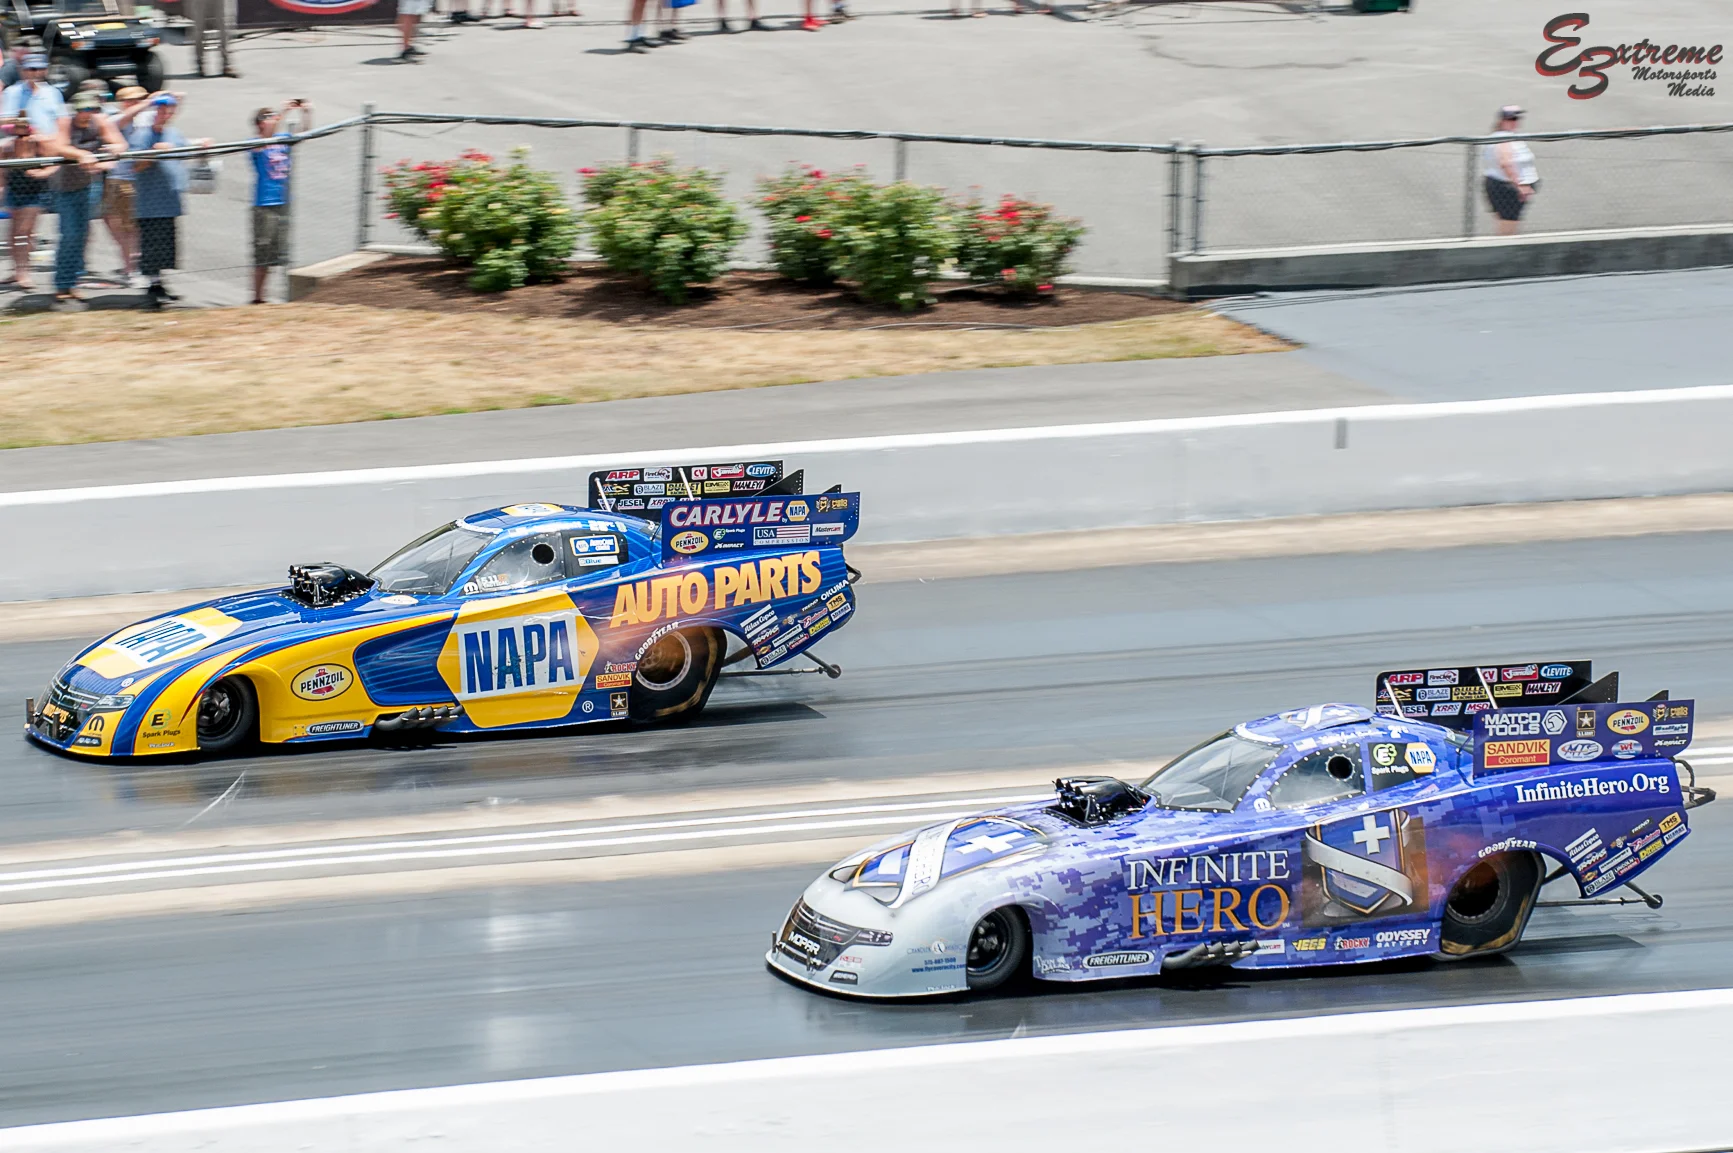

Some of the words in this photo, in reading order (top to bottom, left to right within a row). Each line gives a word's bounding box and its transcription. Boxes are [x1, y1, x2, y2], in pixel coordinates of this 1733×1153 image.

[607, 470, 640, 480] ARP
[693, 469, 705, 477] CV
[746, 464, 777, 477] CLEVITE
[618, 498, 643, 507] JESEL
[670, 501, 784, 528] CARLYLE
[788, 505, 807, 517] NAPA
[756, 529, 776, 538] USA
[675, 535, 705, 548] PENNZOIL
[754, 537, 809, 545] COMPRESSION
[609, 571, 709, 630] AUTO
[713, 551, 822, 610] PARTS
[820, 579, 850, 601] OKUMA
[828, 594, 843, 608] TMS
[744, 617, 761, 634] Atlas
[757, 609, 776, 625] Copco
[113, 619, 208, 663] NAPA
[634, 620, 682, 661] GOODYEAR
[464, 619, 576, 694] NAPA
[611, 662, 638, 672] ROCKY
[1540, 665, 1572, 678] CLEVITE
[300, 673, 346, 694] PENNZOIL
[597, 673, 630, 683] SANDVIK
[1388, 673, 1423, 683] ARP
[1427, 688, 1449, 696] BLAZE
[1453, 686, 1488, 697] BULLE
[1435, 703, 1454, 713] XRP
[1467, 702, 1488, 711] MSD
[1484, 712, 1541, 726] MATCO
[1613, 715, 1645, 728] PENNZOIL
[143, 730, 161, 739] Spark
[162, 729, 181, 738] Plugs
[310, 721, 361, 734] FREIGHTLINER
[1484, 724, 1541, 737] TOOLS
[1486, 740, 1548, 755] SANDVIK
[1409, 749, 1433, 766] NAPA
[1498, 755, 1537, 765] Coromant
[1371, 766, 1390, 775] Spark
[1391, 764, 1410, 774] Plugs
[1514, 773, 1670, 804] InfiniteHero.Org
[1662, 815, 1678, 829] TMS
[1477, 837, 1538, 859] GOODYEAR
[1569, 841, 1587, 858] Atlas
[1583, 833, 1600, 849] Copco
[1126, 849, 1291, 891] INFINITE
[1127, 884, 1291, 940] HERO
[1375, 928, 1431, 943] ODYSSEY
[788, 930, 821, 956] MOPAR
[1295, 937, 1327, 951] JEGS
[1343, 937, 1371, 950] ROCKY
[1376, 939, 1428, 948] BATTERY
[1088, 953, 1150, 966] FREIGHTLINER
